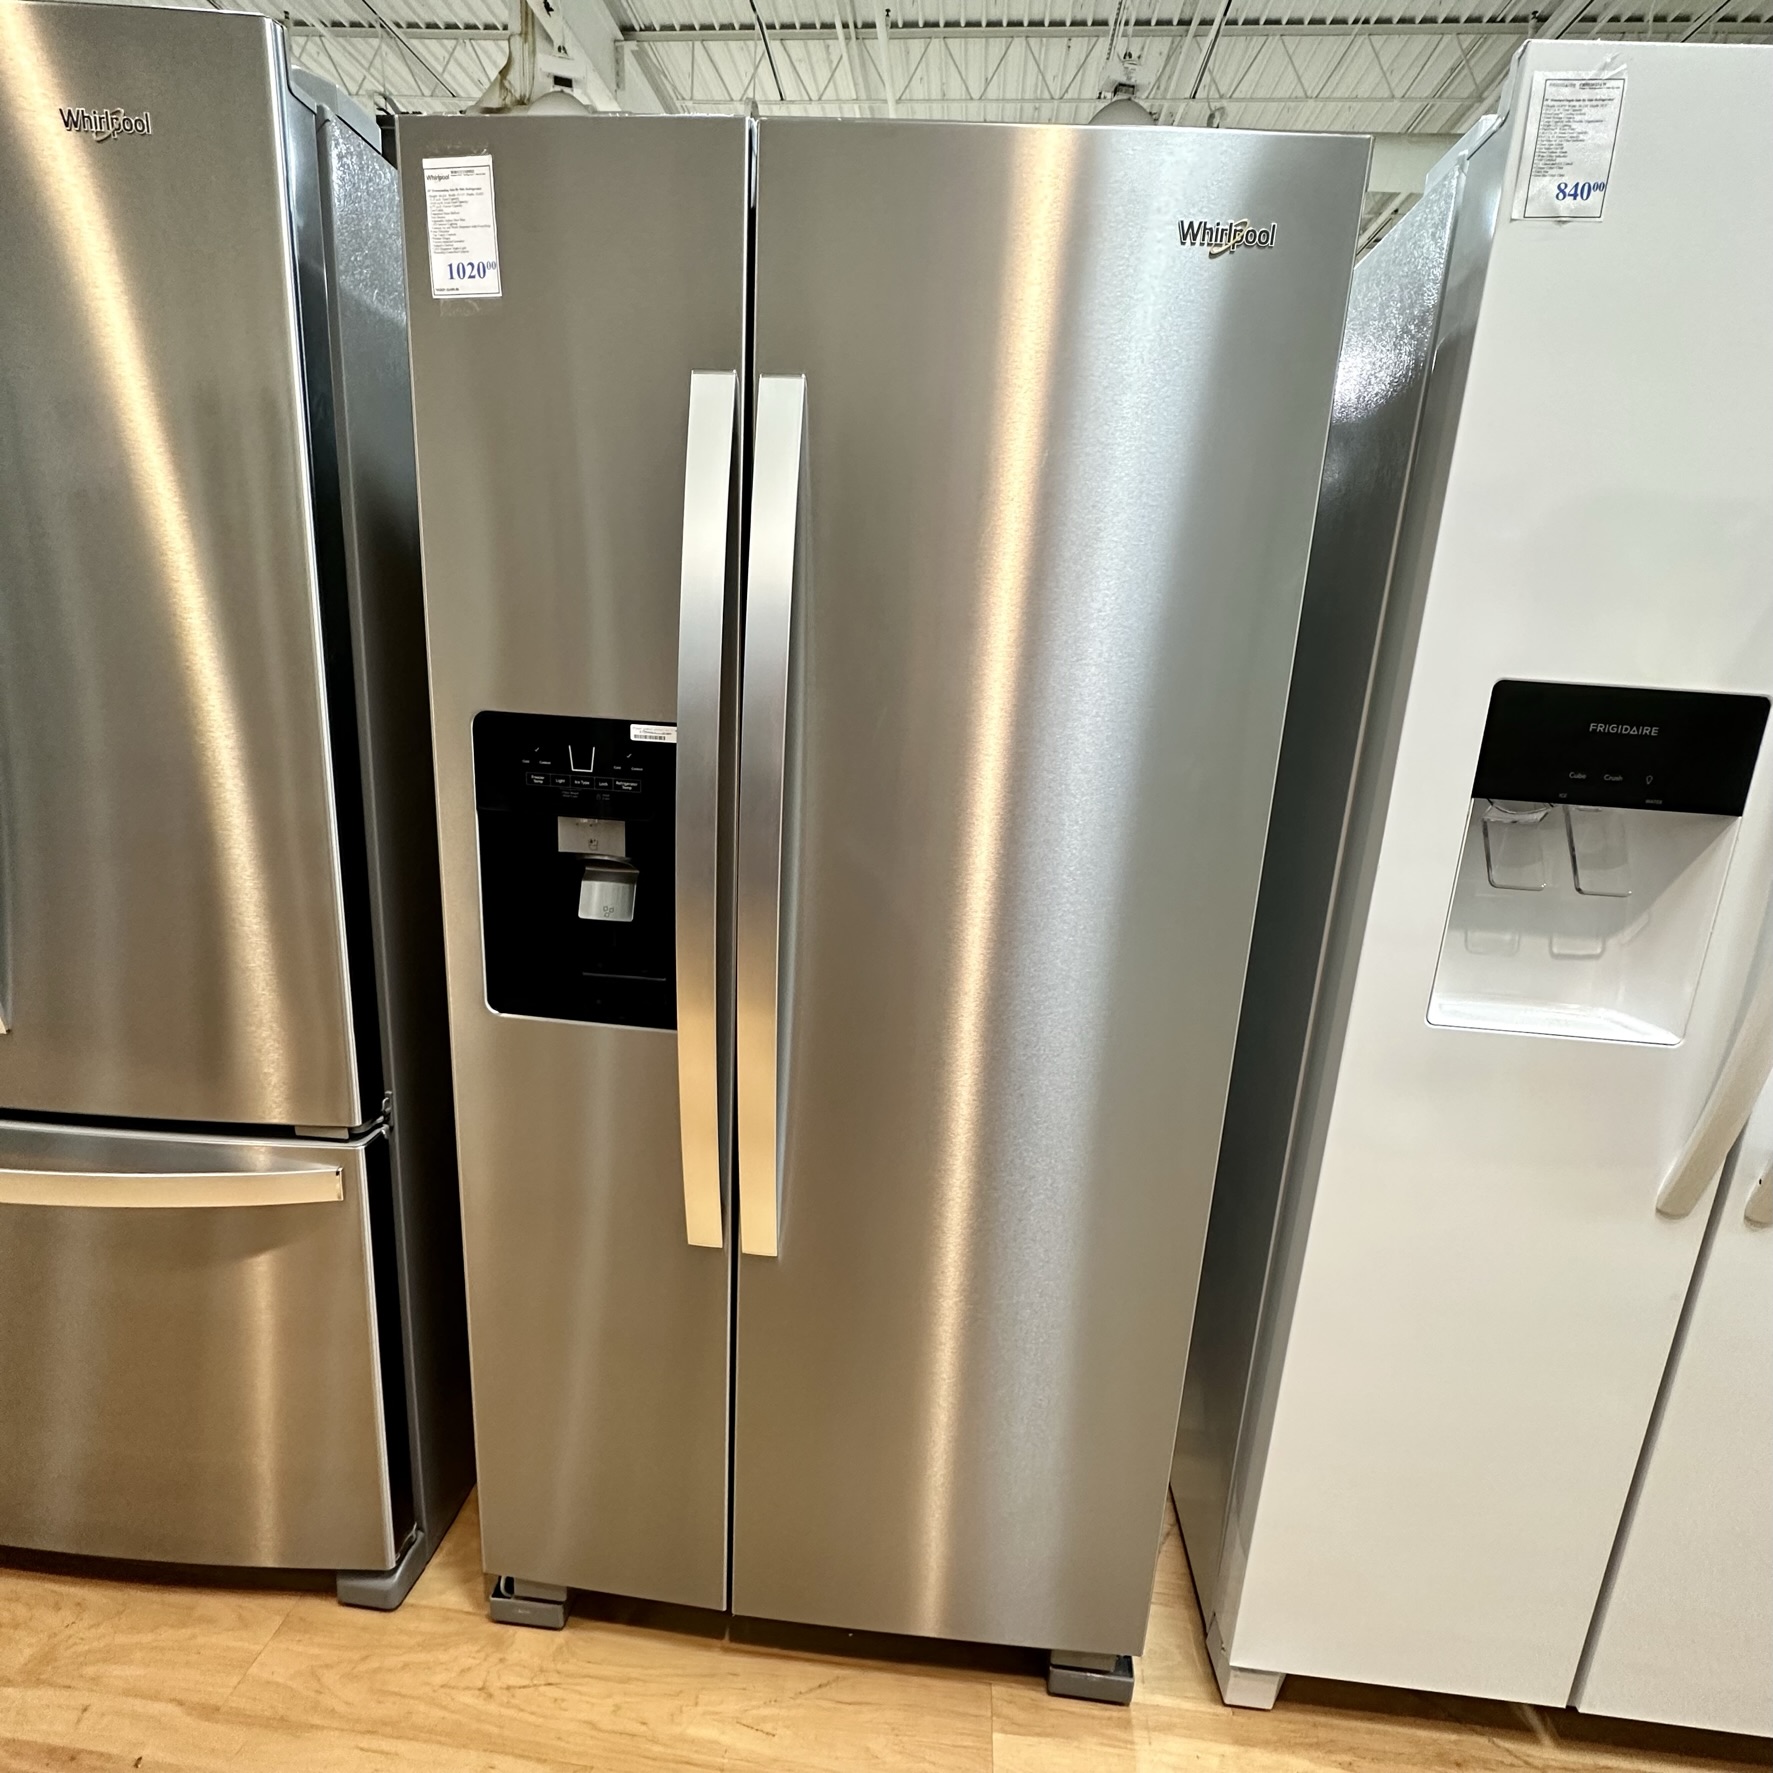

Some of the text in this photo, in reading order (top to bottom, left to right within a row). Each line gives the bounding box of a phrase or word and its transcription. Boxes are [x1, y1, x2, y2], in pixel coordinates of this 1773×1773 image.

[59, 108, 151, 140] Whirlpool
[1178, 219, 1277, 254] Whirlpool
[1589, 723, 1660, 736] FRIGIDAIRE
[1569, 771, 1587, 779] Cube
